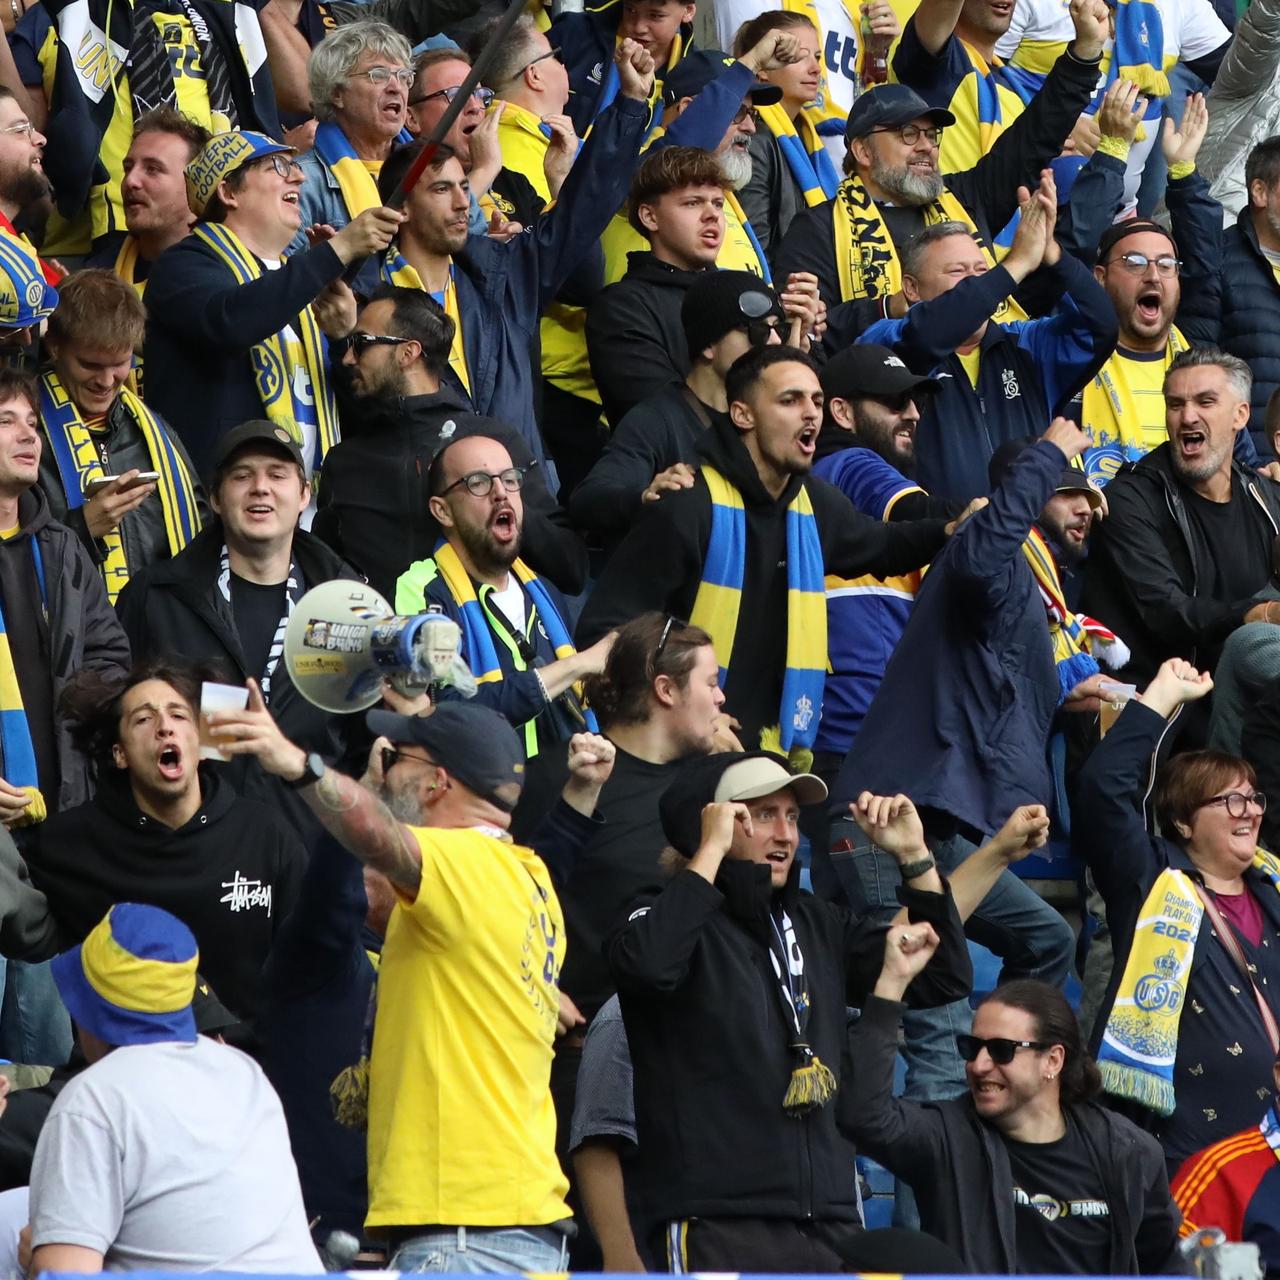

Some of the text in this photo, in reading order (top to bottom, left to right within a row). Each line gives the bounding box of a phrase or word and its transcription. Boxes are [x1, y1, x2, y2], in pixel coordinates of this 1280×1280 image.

[188, 132, 239, 187] HATEFUL
[197, 139, 250, 205] FOOTBALL
[1132, 972, 1184, 1017] USG
